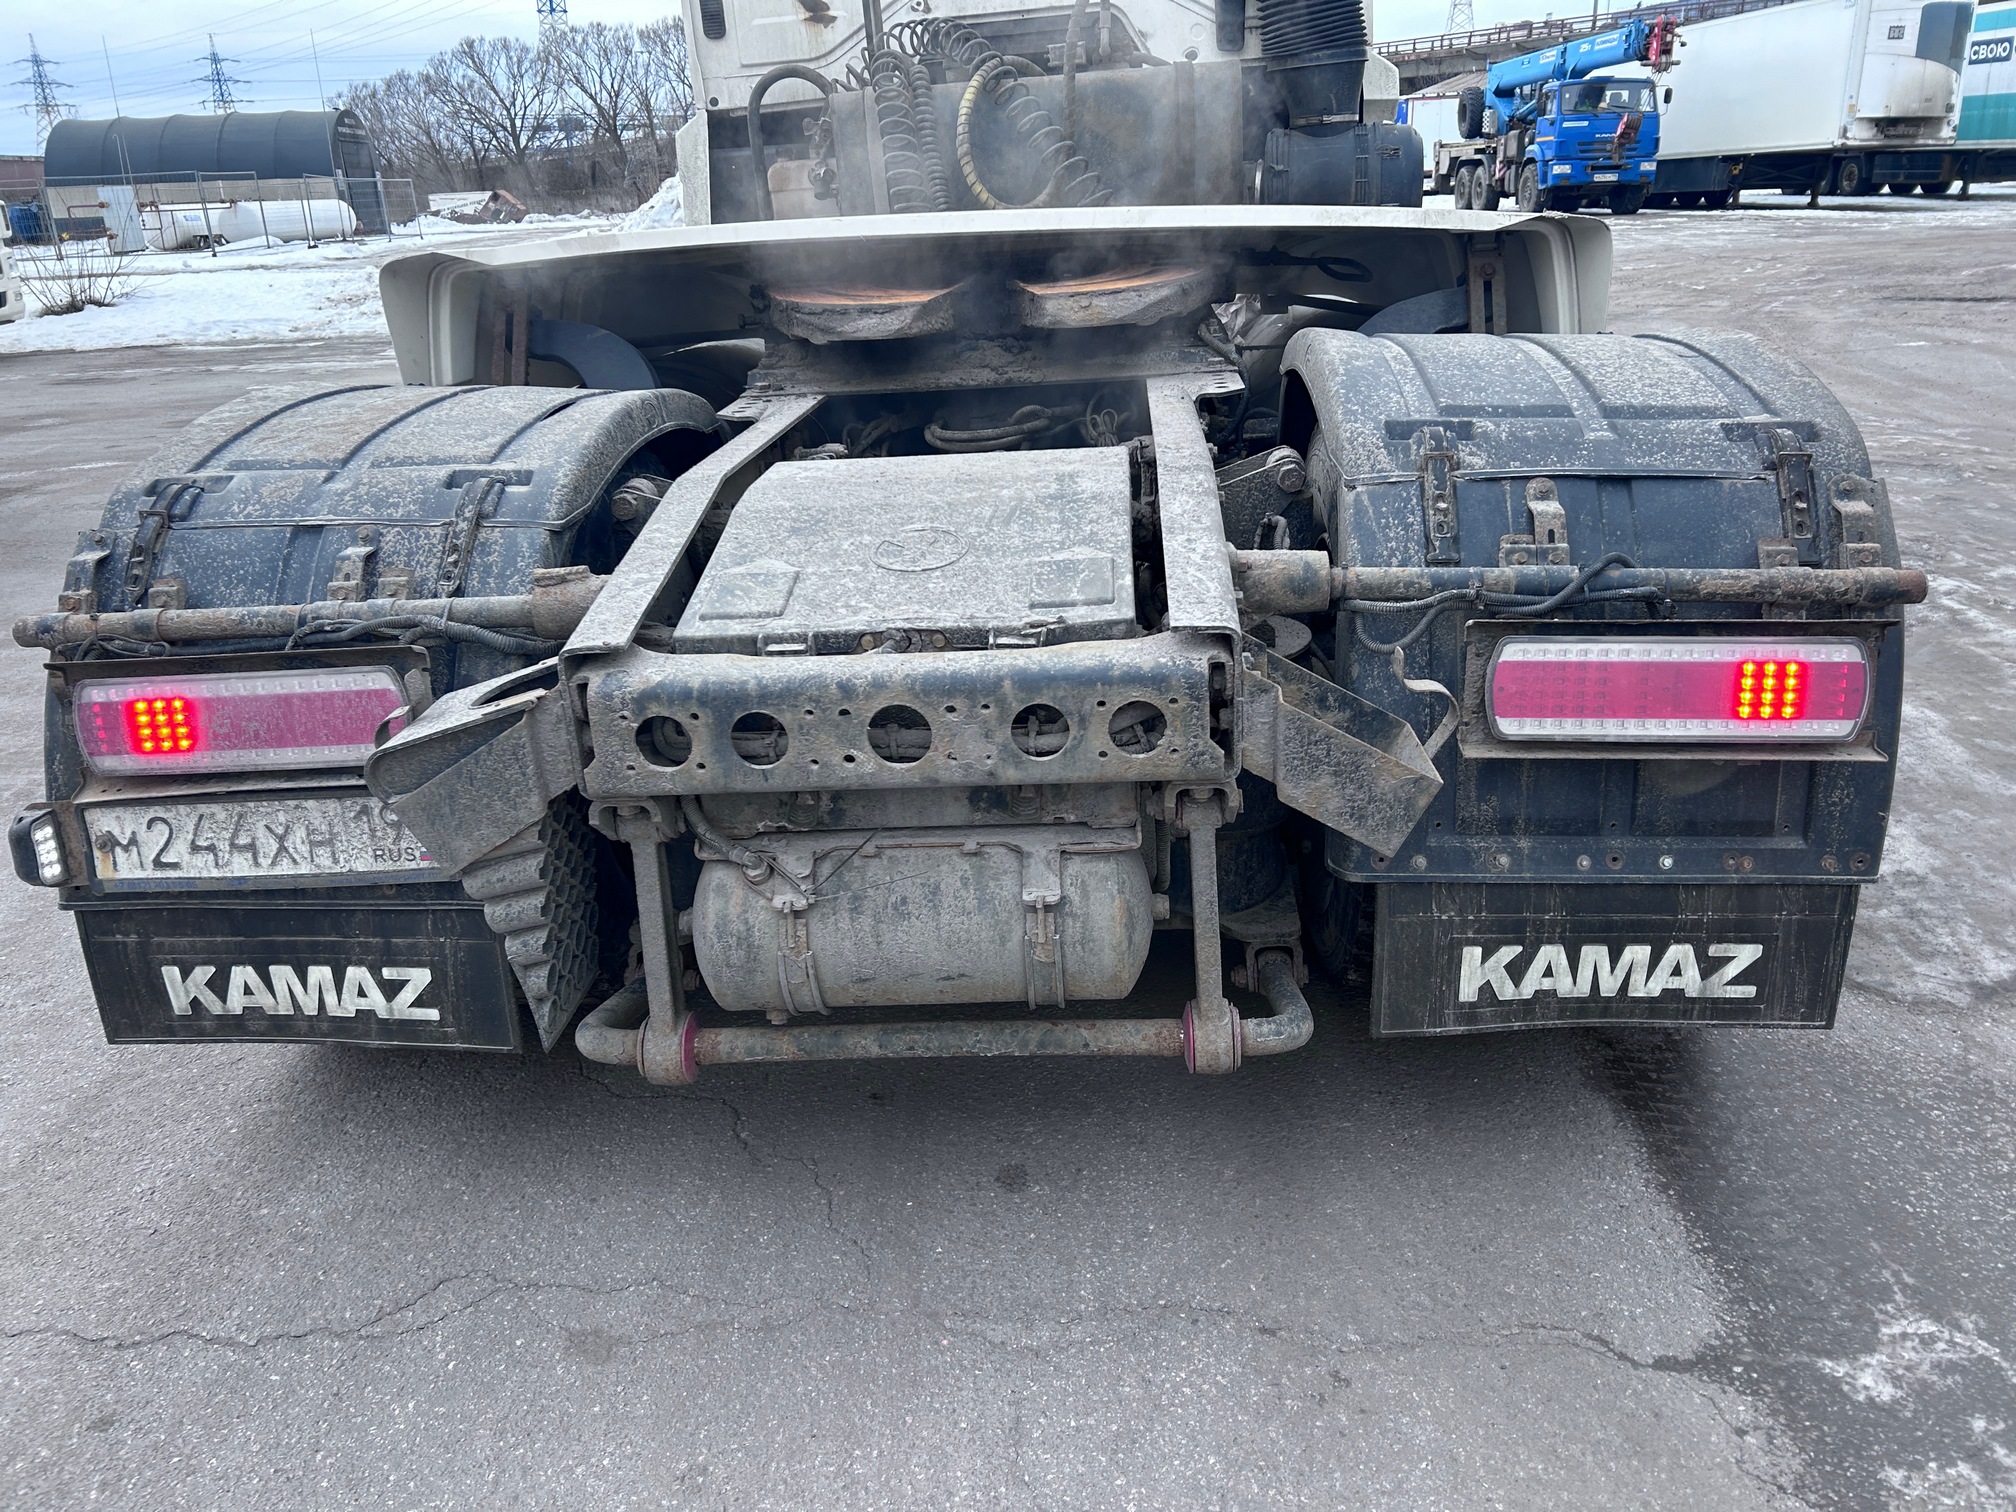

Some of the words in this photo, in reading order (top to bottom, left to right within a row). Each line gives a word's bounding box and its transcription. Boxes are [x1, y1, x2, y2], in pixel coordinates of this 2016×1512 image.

[1970, 42, 2010, 60] СВОЮ
[374, 846, 417, 862] RUS
[1458, 943, 1764, 1003] KAMAZ
[160, 965, 441, 1021] KAMAZ
